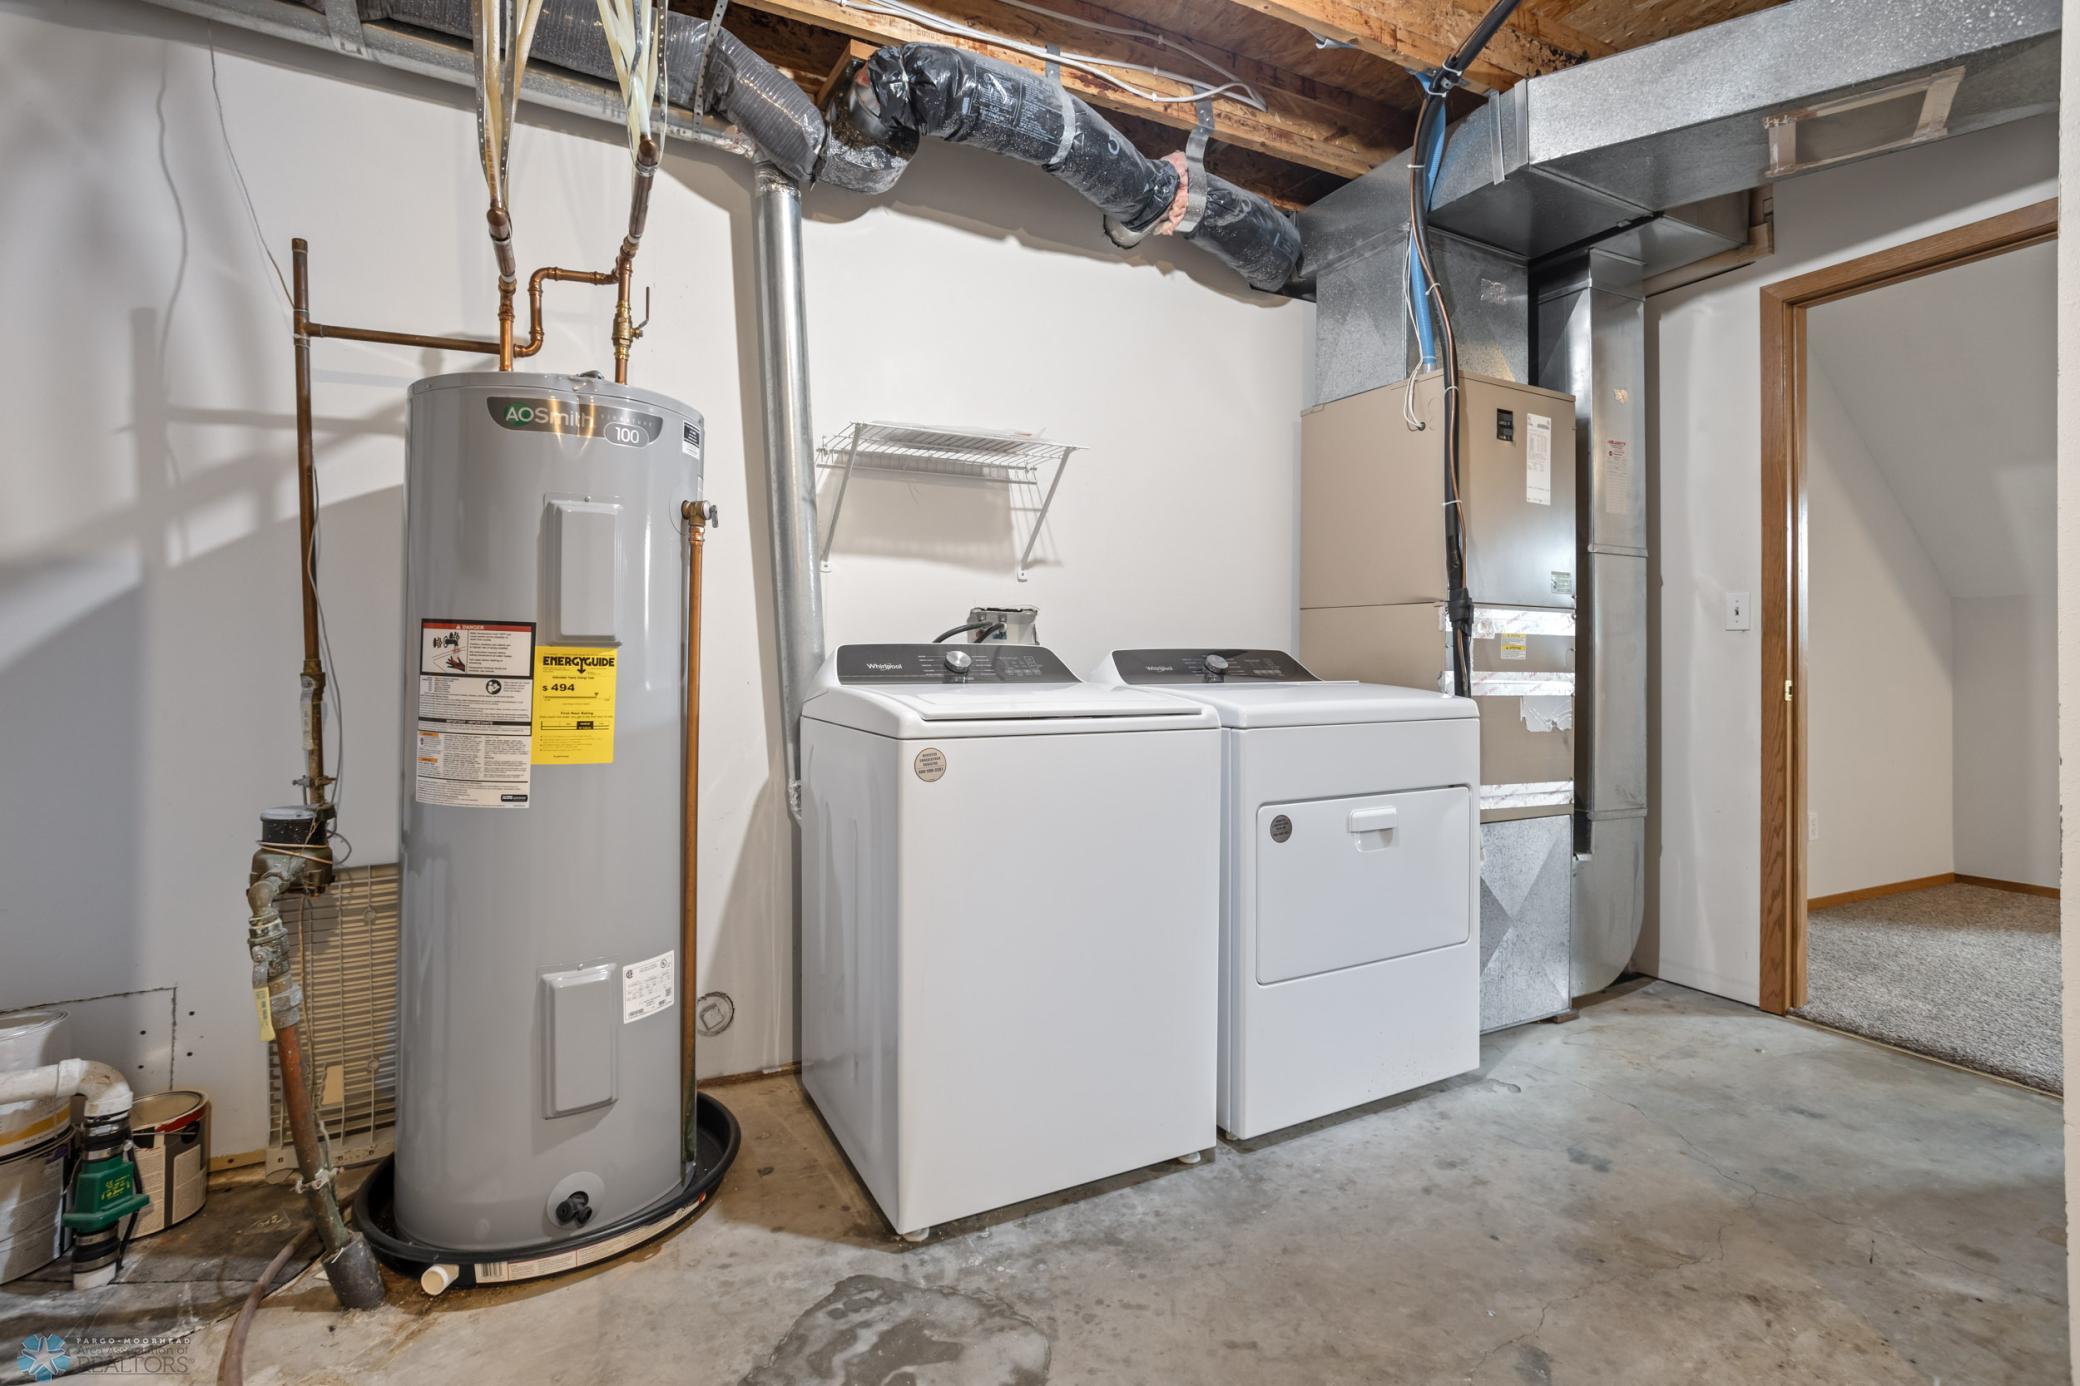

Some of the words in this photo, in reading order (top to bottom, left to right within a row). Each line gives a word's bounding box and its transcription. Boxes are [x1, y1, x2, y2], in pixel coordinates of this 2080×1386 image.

[615, 426, 640, 444] 100
[865, 662, 903, 671] Whirlpool
[551, 683, 575, 692] 494
